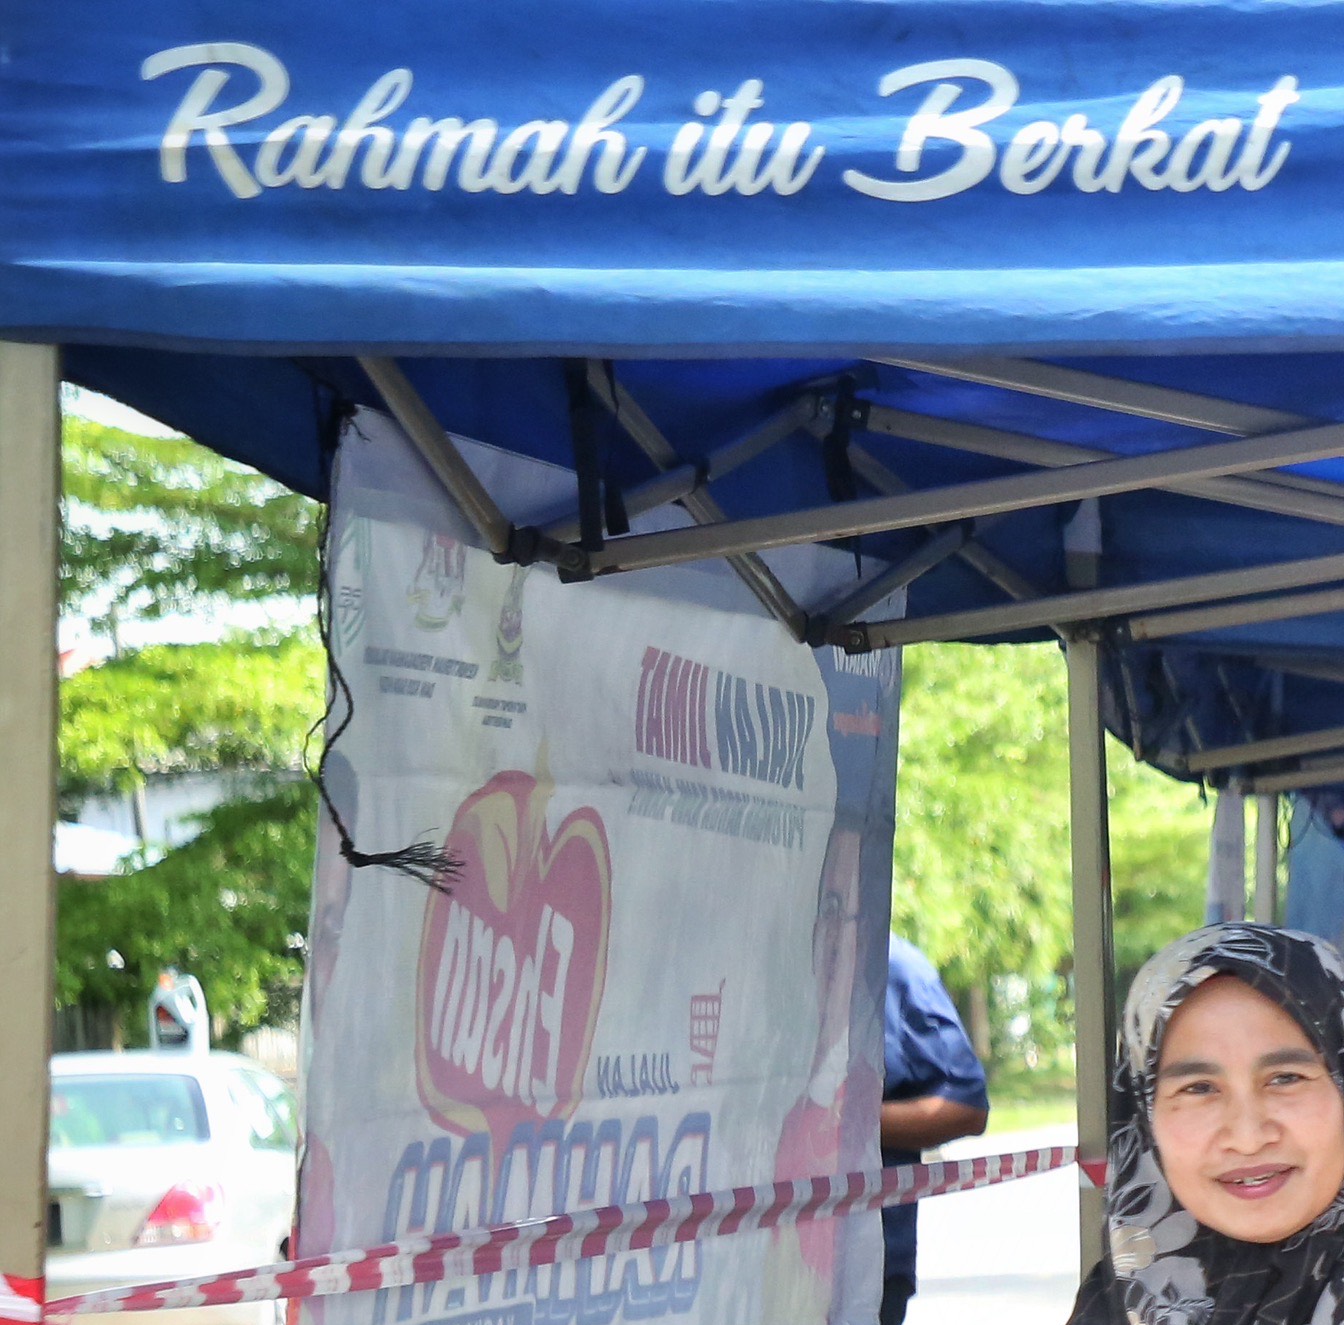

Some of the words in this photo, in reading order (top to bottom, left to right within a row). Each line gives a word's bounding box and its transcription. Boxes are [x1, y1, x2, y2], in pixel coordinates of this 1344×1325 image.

[141, 42, 646, 199] Rahmah
[664, 79, 824, 196] itu
[843, 58, 1299, 202] Berkat
